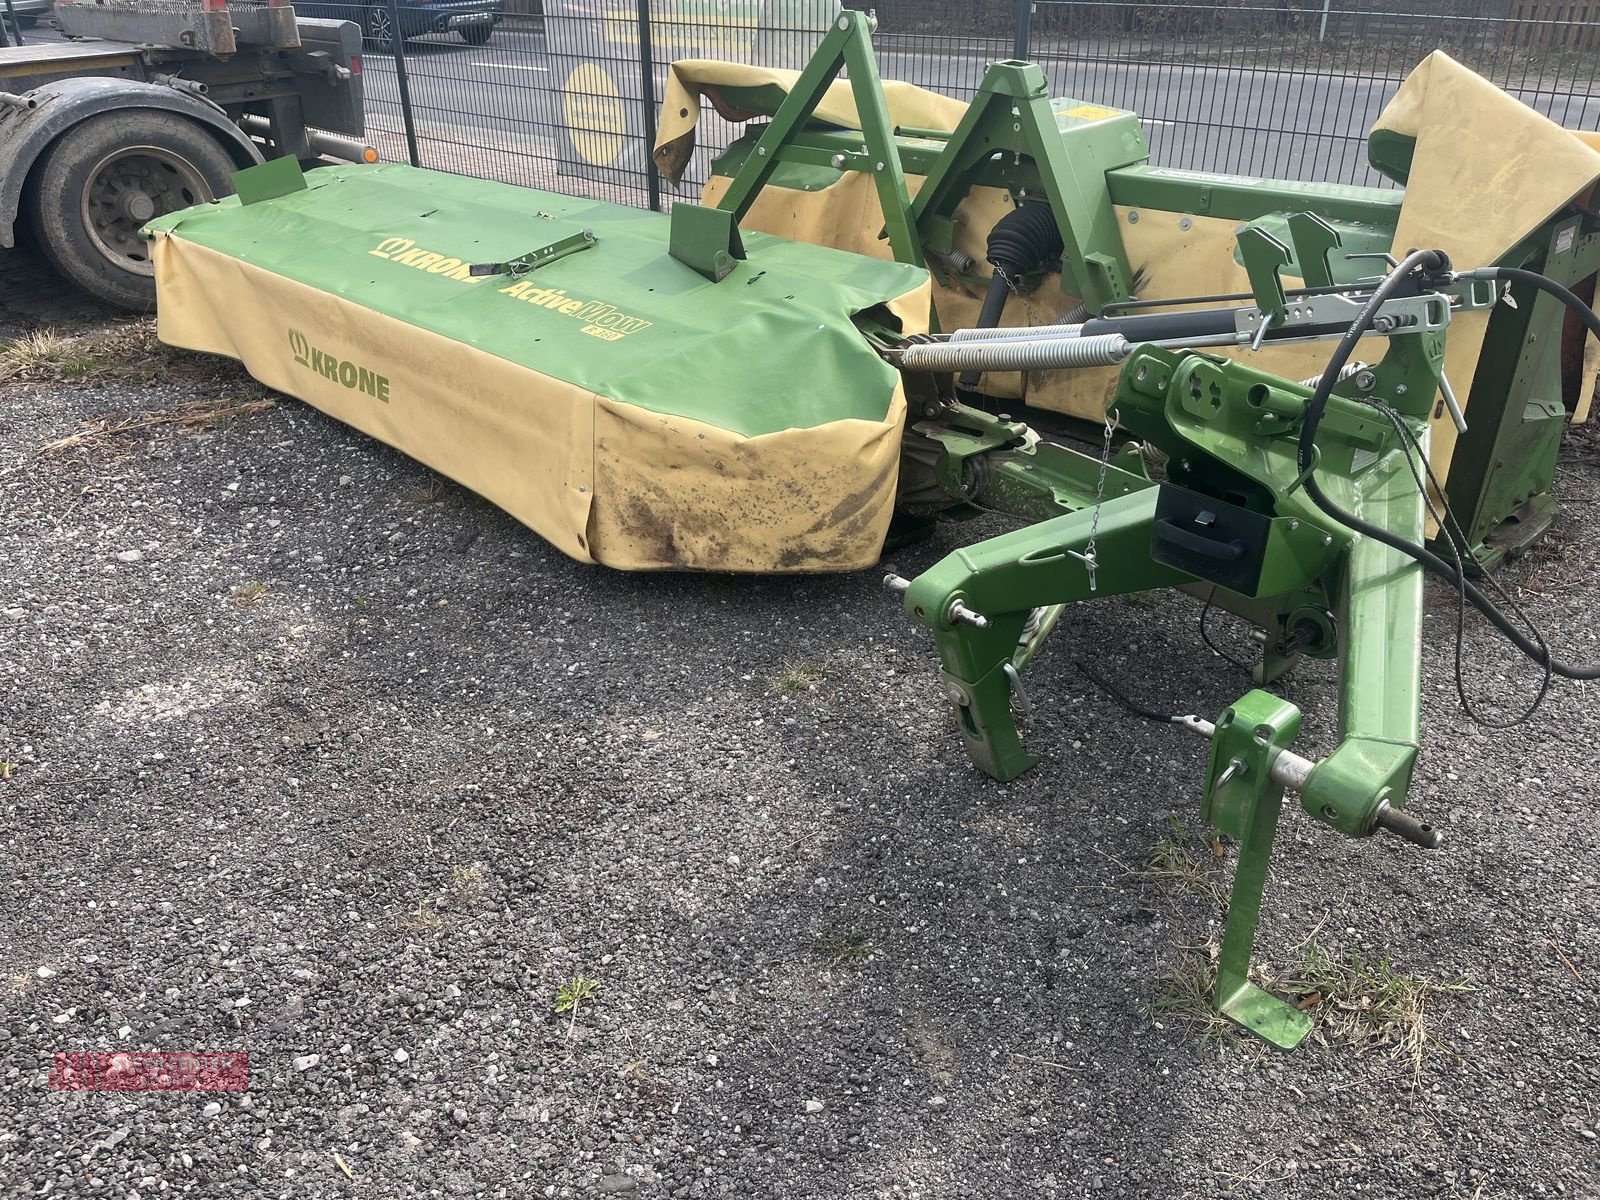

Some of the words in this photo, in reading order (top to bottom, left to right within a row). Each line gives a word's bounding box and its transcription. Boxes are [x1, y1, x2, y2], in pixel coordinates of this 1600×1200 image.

[499, 281, 652, 335] ActiveMow
[594, 328, 618, 340] 360
[311, 346, 390, 405] KRONE
